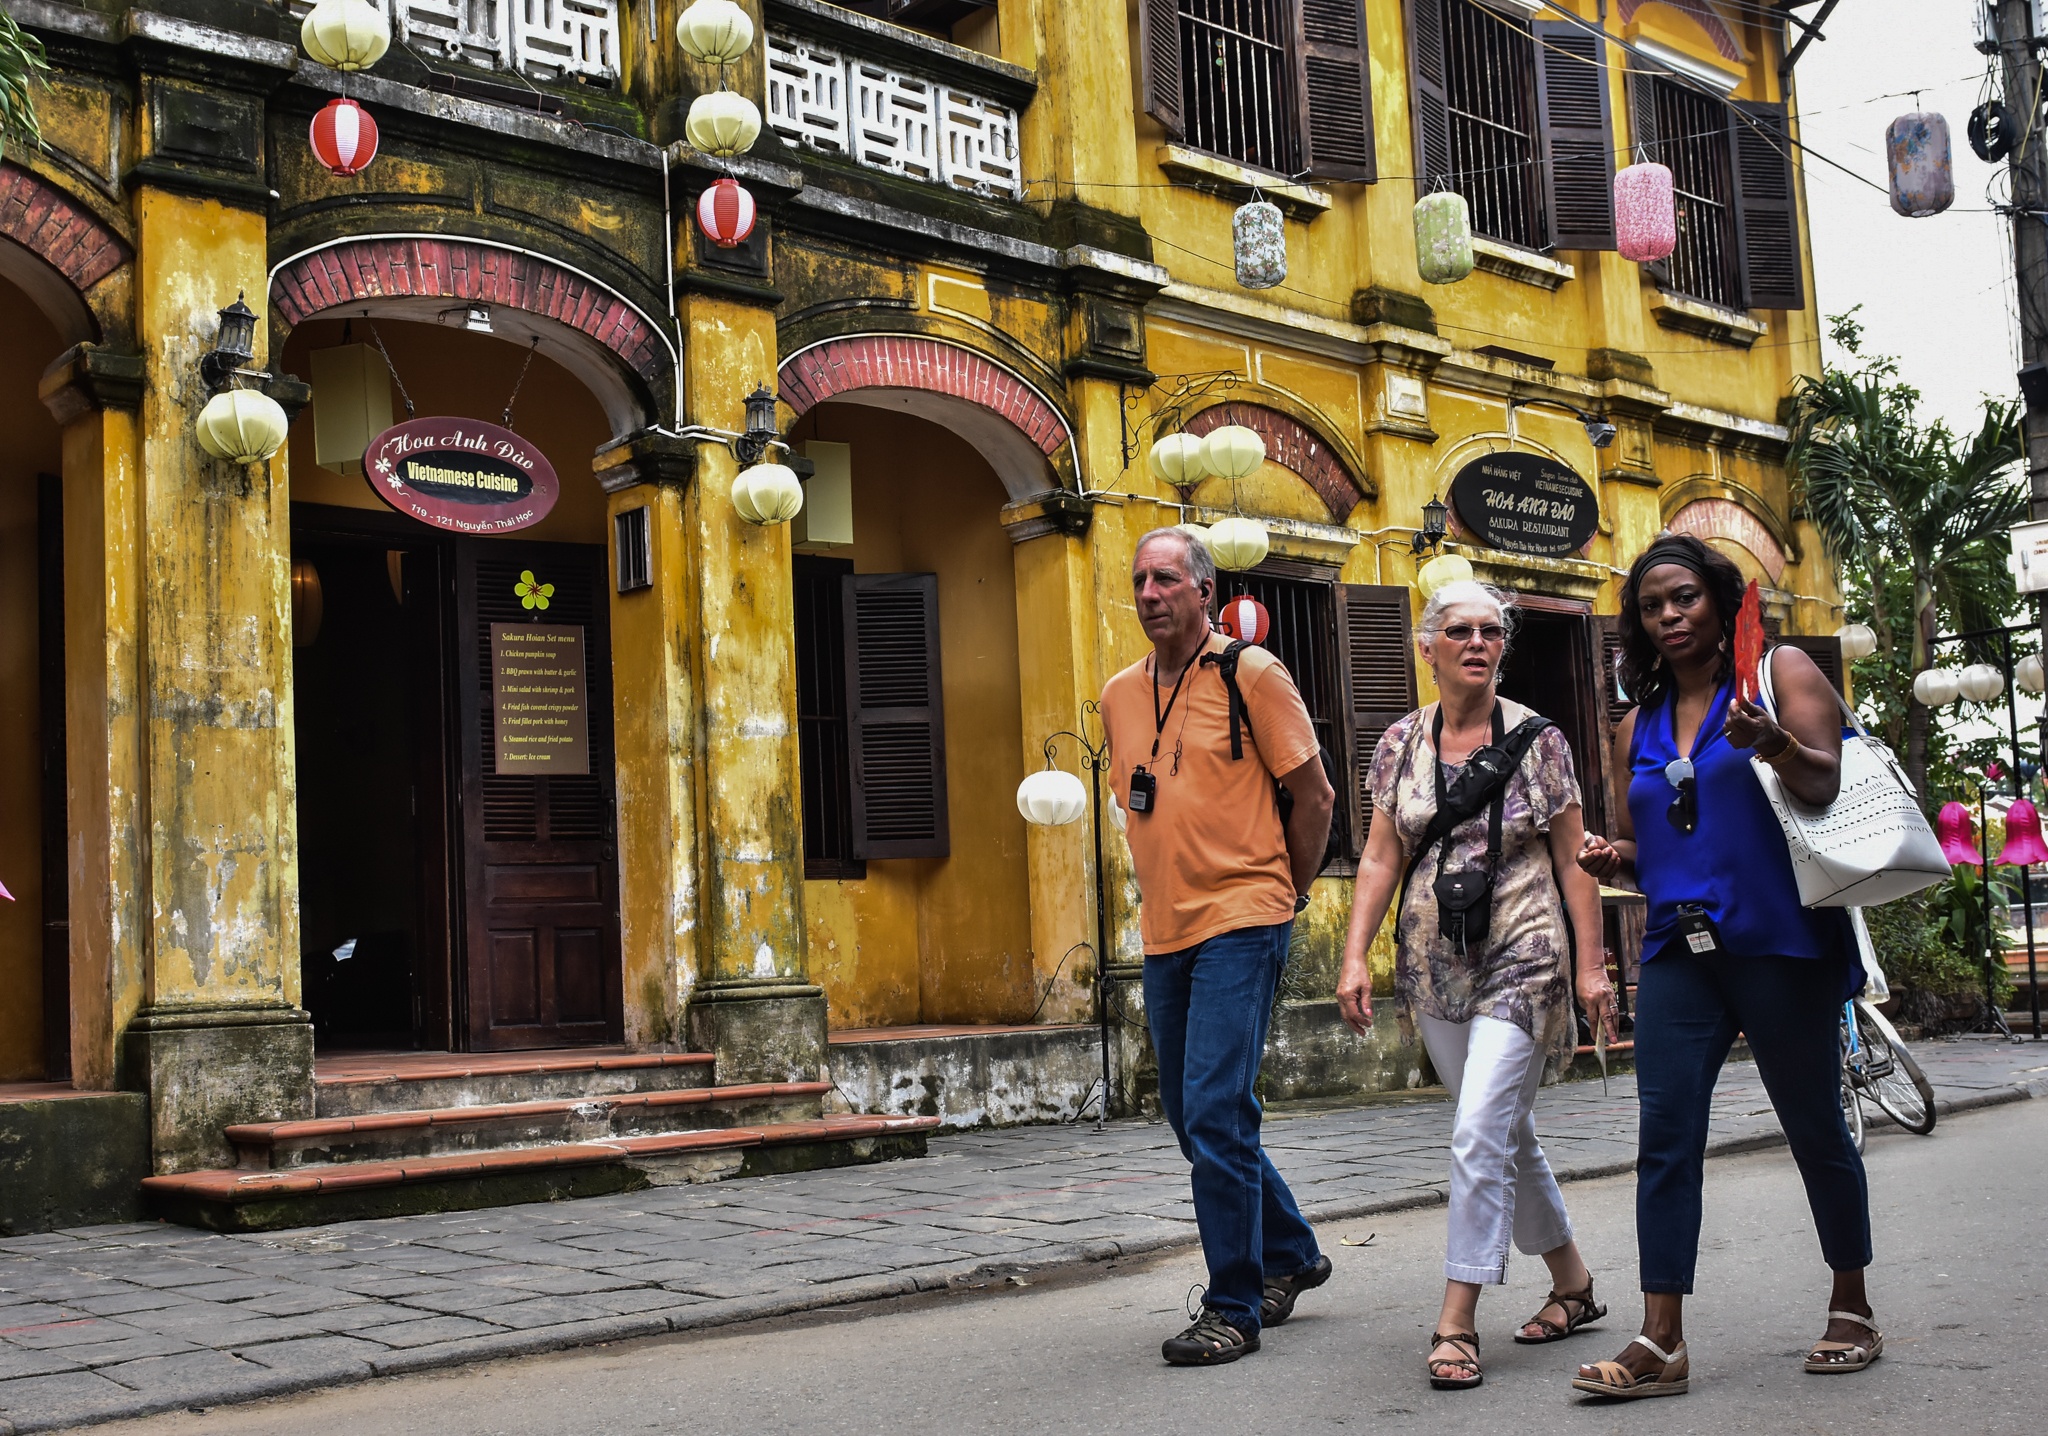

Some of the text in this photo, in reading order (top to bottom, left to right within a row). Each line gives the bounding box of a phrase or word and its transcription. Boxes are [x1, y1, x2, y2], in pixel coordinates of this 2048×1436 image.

[389, 430, 534, 469] Hoa Anh Đào
[406, 461, 519, 493] Vietnamese Cuisine
[1509, 470, 1522, 482] VIỆT
[1482, 489, 1515, 511] HOA
[1516, 496, 1549, 517] ANH
[411, 504, 428, 517] 119
[436, 515, 453, 526] 121
[456, 519, 493, 532] Nguyễn
[495, 517, 516, 529] Thái
[515, 509, 534, 522] Học
[1488, 516, 1570, 538] SAKURA RESTAURANT
[501, 633, 525, 642] Sakura
[526, 633, 545, 642] Hoian
[546, 634, 556, 642] Set
[524, 650, 545, 659] pumpkin
[545, 652, 557, 660] soup
[500, 667, 505, 675] 2.
[506, 667, 518, 677] BBQ
[518, 669, 533, 677] prawn
[544, 668, 558, 676] butter
[558, 668, 563, 676] &
[563, 668, 577, 677] garlic
[507, 685, 519, 693] Mini
[518, 685, 532, 693] salad
[531, 685, 542, 693] with
[542, 685, 559, 695] shrimp
[564, 686, 575, 695] pork
[520, 703, 530, 712] fish
[530, 703, 548, 711] covered
[547, 704, 562, 712] crispy
[561, 704, 579, 712] powder
[508, 717, 521, 725] Fried
[532, 718, 544, 726] pork
[554, 718, 568, 726] honey
[508, 735, 528, 743] Steamed
[528, 735, 538, 743] rice
[537, 735, 548, 743] and
[546, 735, 559, 744] fried
[558, 736, 574, 744] potato
[504, 752, 509, 760] 7.
[528, 752, 536, 760] Ice
